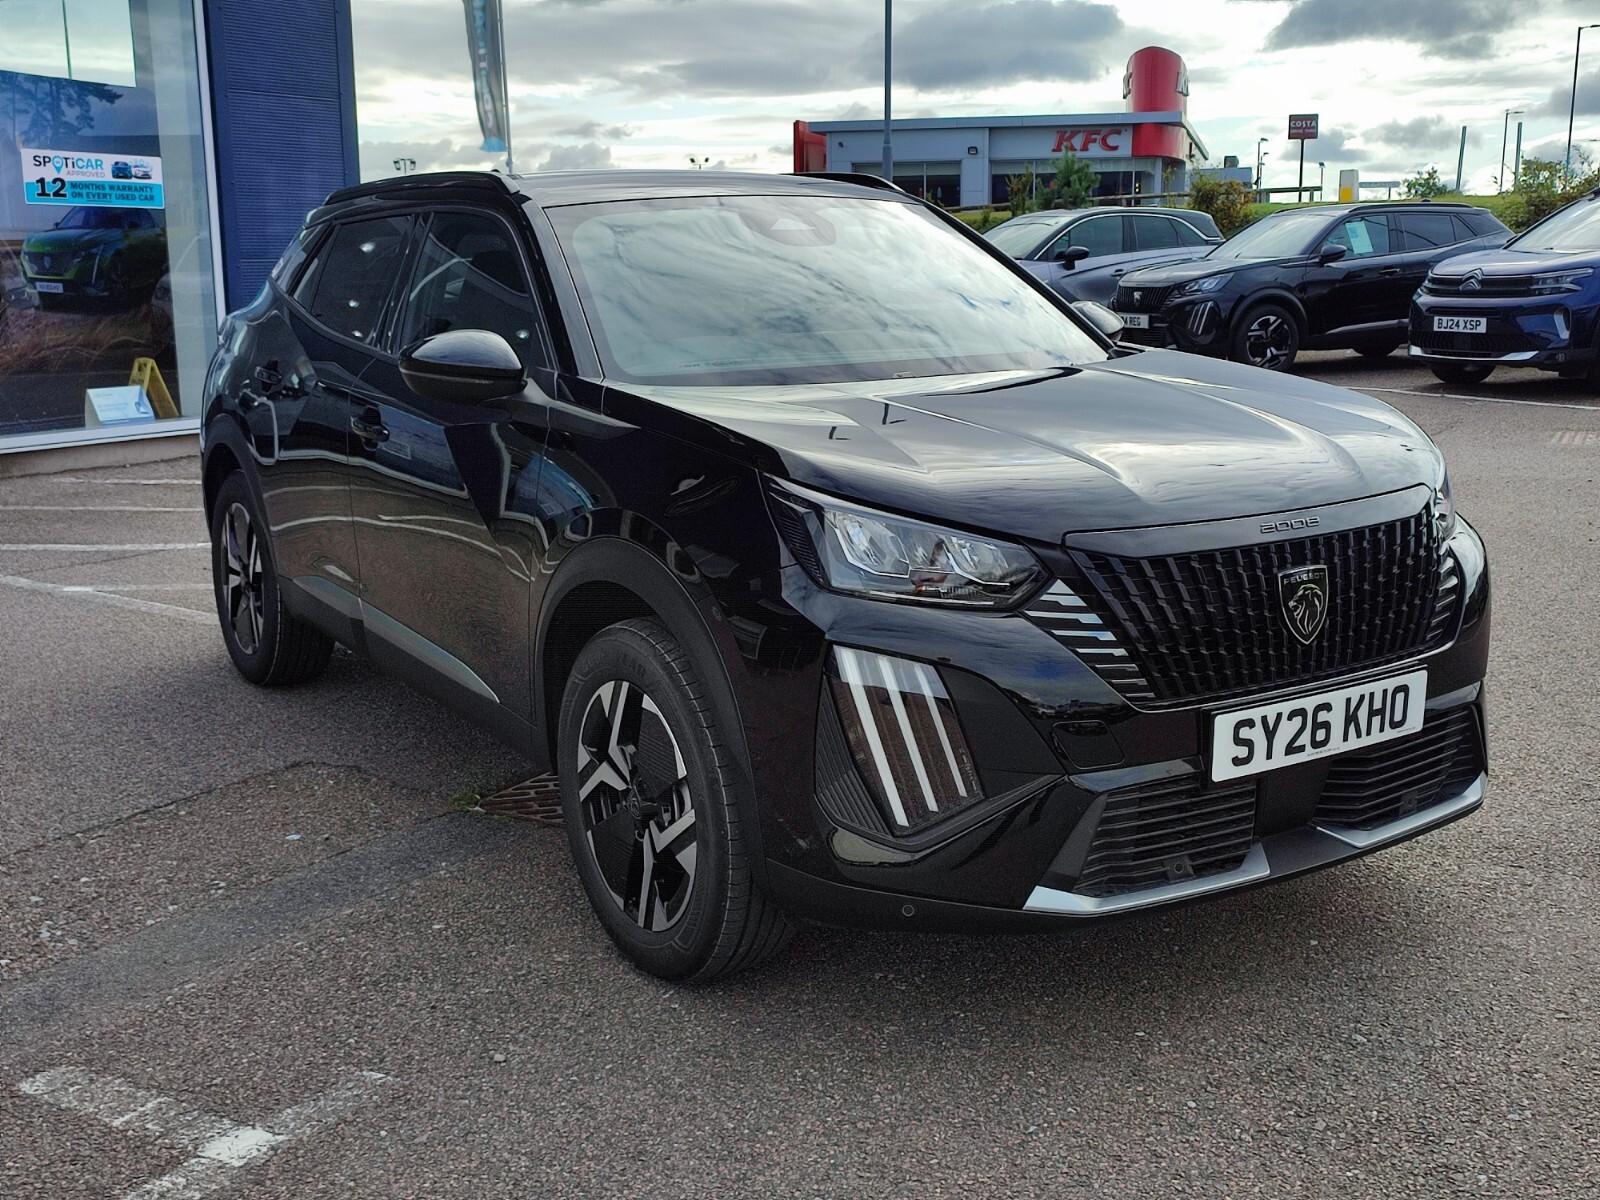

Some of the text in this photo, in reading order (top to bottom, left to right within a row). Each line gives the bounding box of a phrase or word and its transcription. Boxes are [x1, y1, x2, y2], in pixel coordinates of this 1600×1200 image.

[1051, 129, 1122, 152] KFC
[66, 170, 106, 178] APPROVED
[35, 177, 67, 198] 12
[70, 182, 154, 193] MONTHS WARRANTY
[71, 191, 155, 202] ON EVERY USED CAR
[1437, 318, 1482, 331] BJ24 XSP
[1260, 516, 1320, 534] 2008
[1283, 572, 1325, 585] PEUGEOT
[1231, 683, 1410, 767] SY26 KHO
